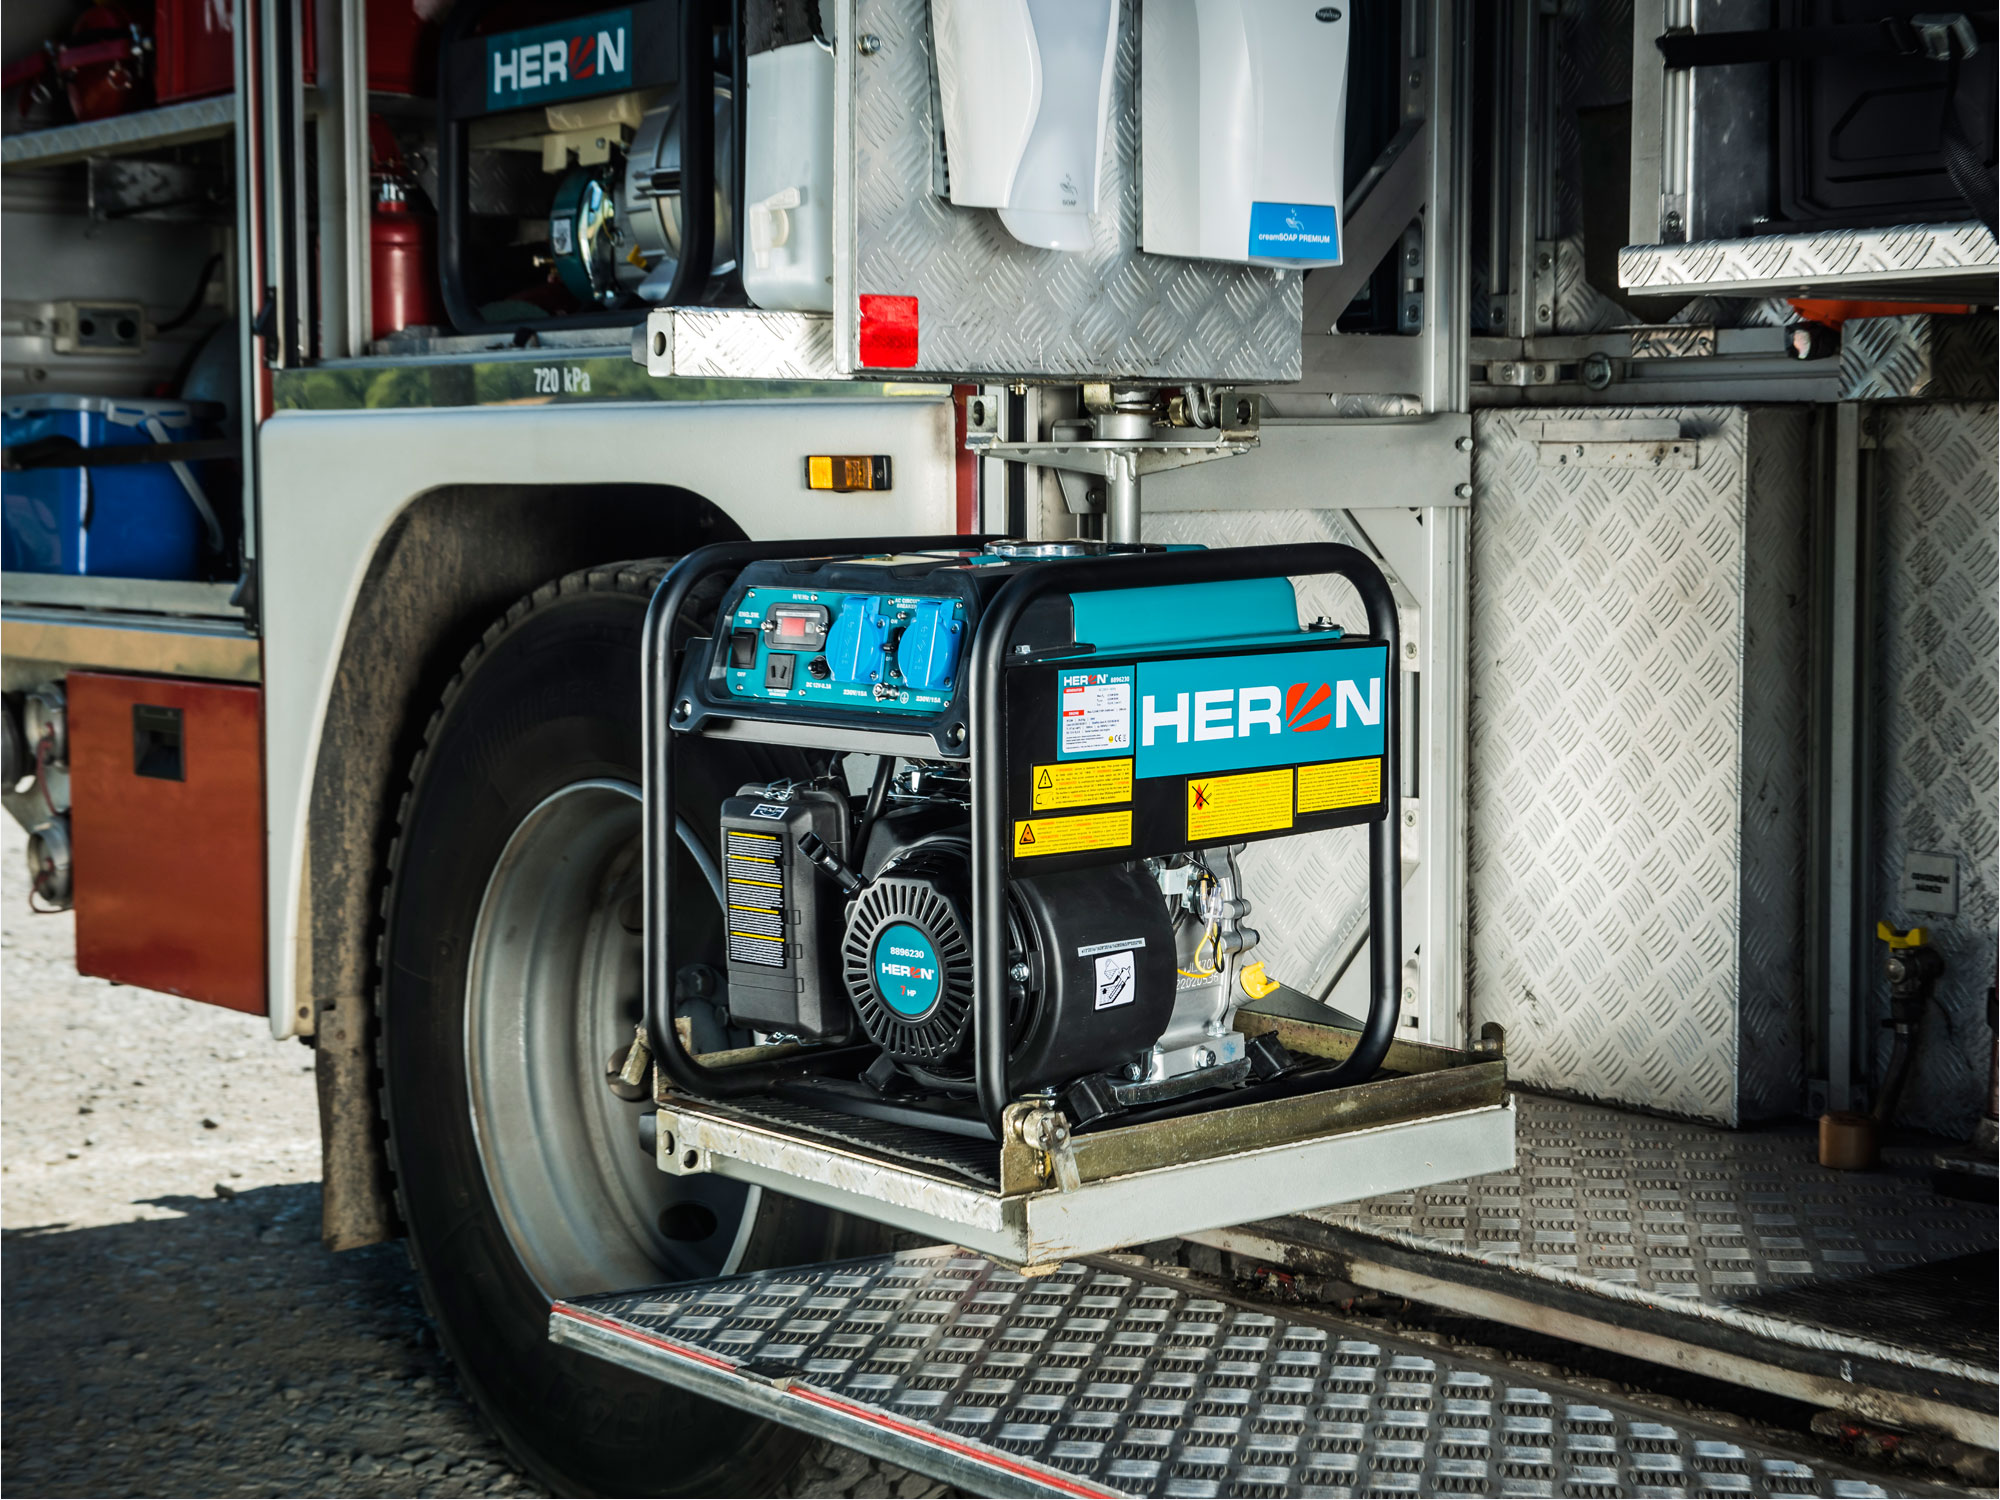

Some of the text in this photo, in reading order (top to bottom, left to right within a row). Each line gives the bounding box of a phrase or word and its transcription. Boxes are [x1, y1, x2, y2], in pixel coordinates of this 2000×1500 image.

[494, 27, 625, 94] HERON
[1258, 232, 1330, 243] creamSOAP PREMIUM
[533, 366, 591, 393] 720 kPa
[1063, 674, 1107, 686] HERON
[1142, 677, 1381, 747] HERON
[890, 947, 924, 959] 8896230
[881, 962, 933, 980] HERON
[900, 985, 917, 997] 7 HP
